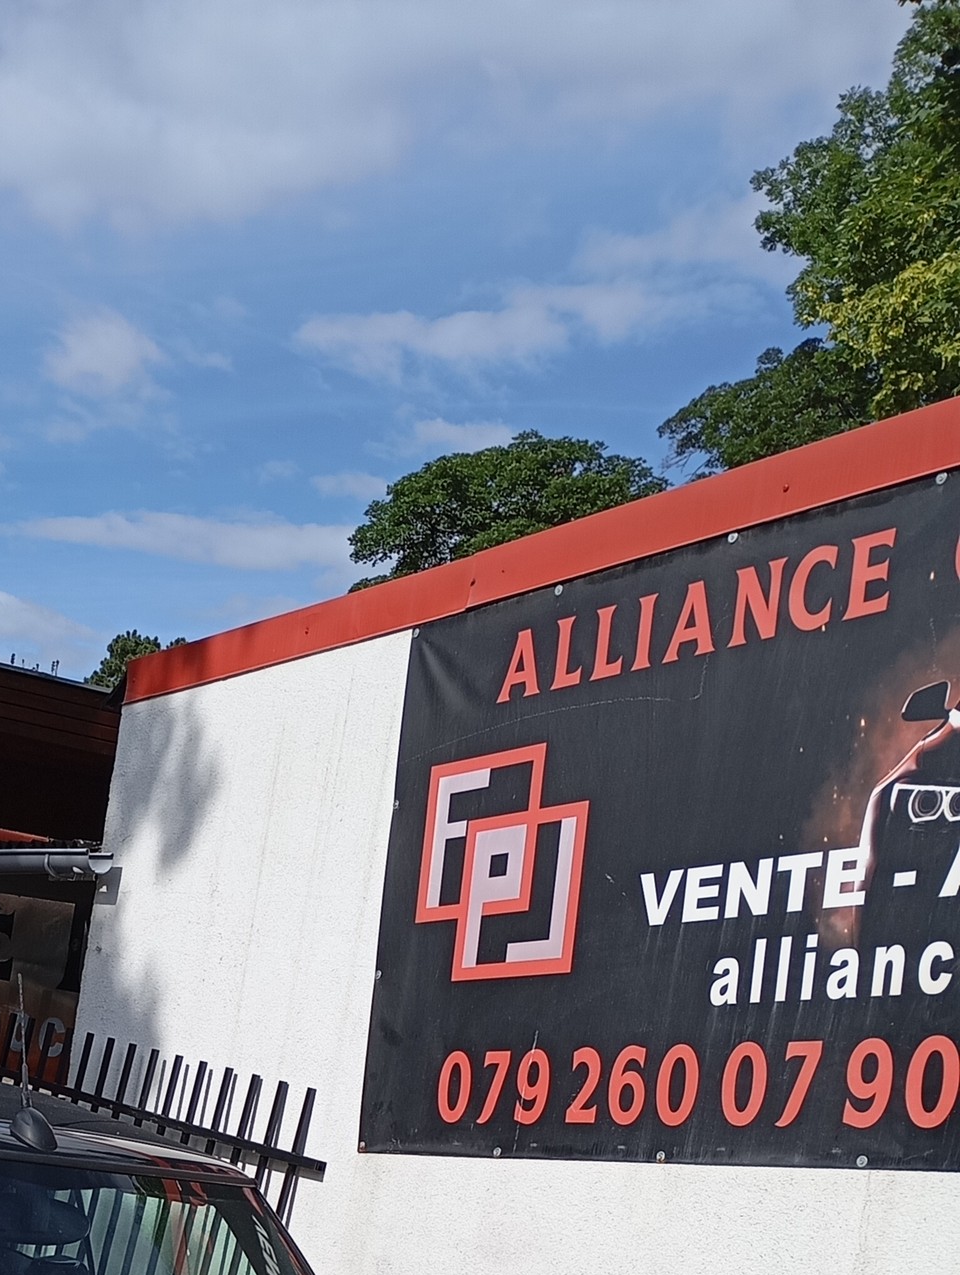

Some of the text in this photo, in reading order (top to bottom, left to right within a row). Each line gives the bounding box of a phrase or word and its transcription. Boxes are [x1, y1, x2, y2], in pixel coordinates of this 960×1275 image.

[496, 527, 897, 703] ALLIANCE
[640, 843, 872, 927] VENTE
[708, 934, 956, 1007] allianc
[436, 1034, 960, 1130] 079 260 07 90
